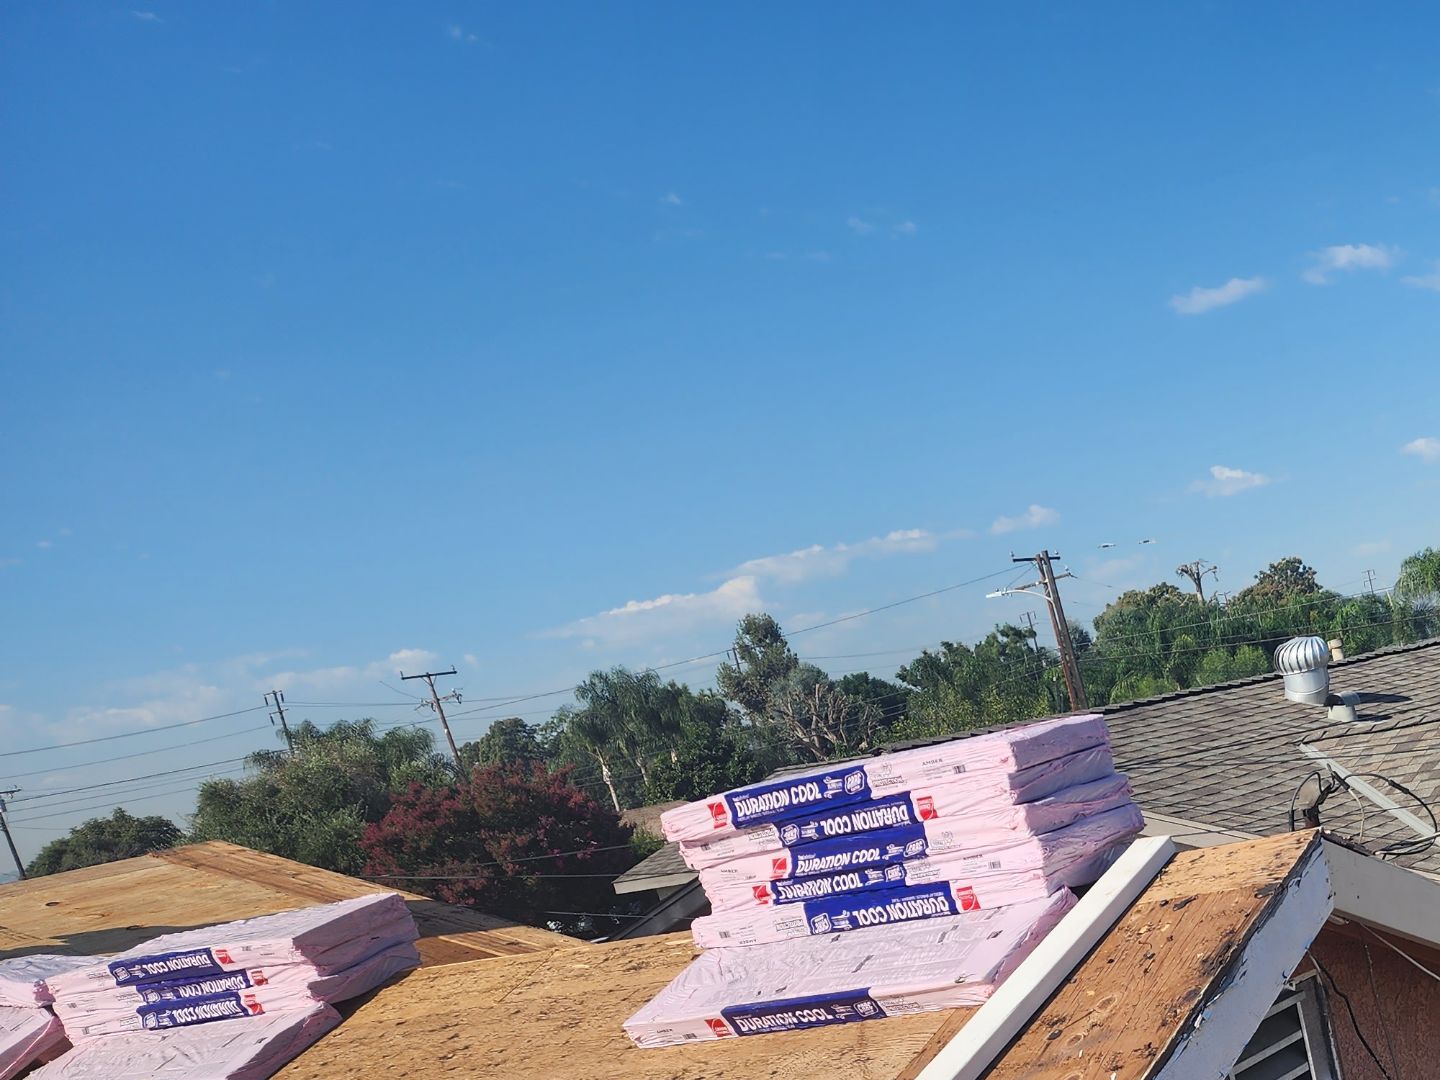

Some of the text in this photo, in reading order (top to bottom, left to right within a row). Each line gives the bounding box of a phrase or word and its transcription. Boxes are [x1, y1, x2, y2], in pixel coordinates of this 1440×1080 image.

[735, 789, 790, 817] DURATION
[792, 782, 822, 805] COOL
[820, 815, 852, 836] COOL
[853, 804, 909, 827] DURATION
[797, 853, 851, 872] DURATION
[852, 848, 881, 865] COOL
[833, 872, 864, 893] COOL
[852, 906, 887, 926] COOL
[888, 896, 949, 921] DURATION
[143, 960, 168, 975] COOL
[168, 954, 211, 971] DURATION
[201, 975, 246, 996] DURATION
[172, 1006, 200, 1024] COOL
[199, 1000, 242, 1020] DURATION
[735, 1013, 799, 1033] DURATION
[798, 1007, 834, 1023] COOL
